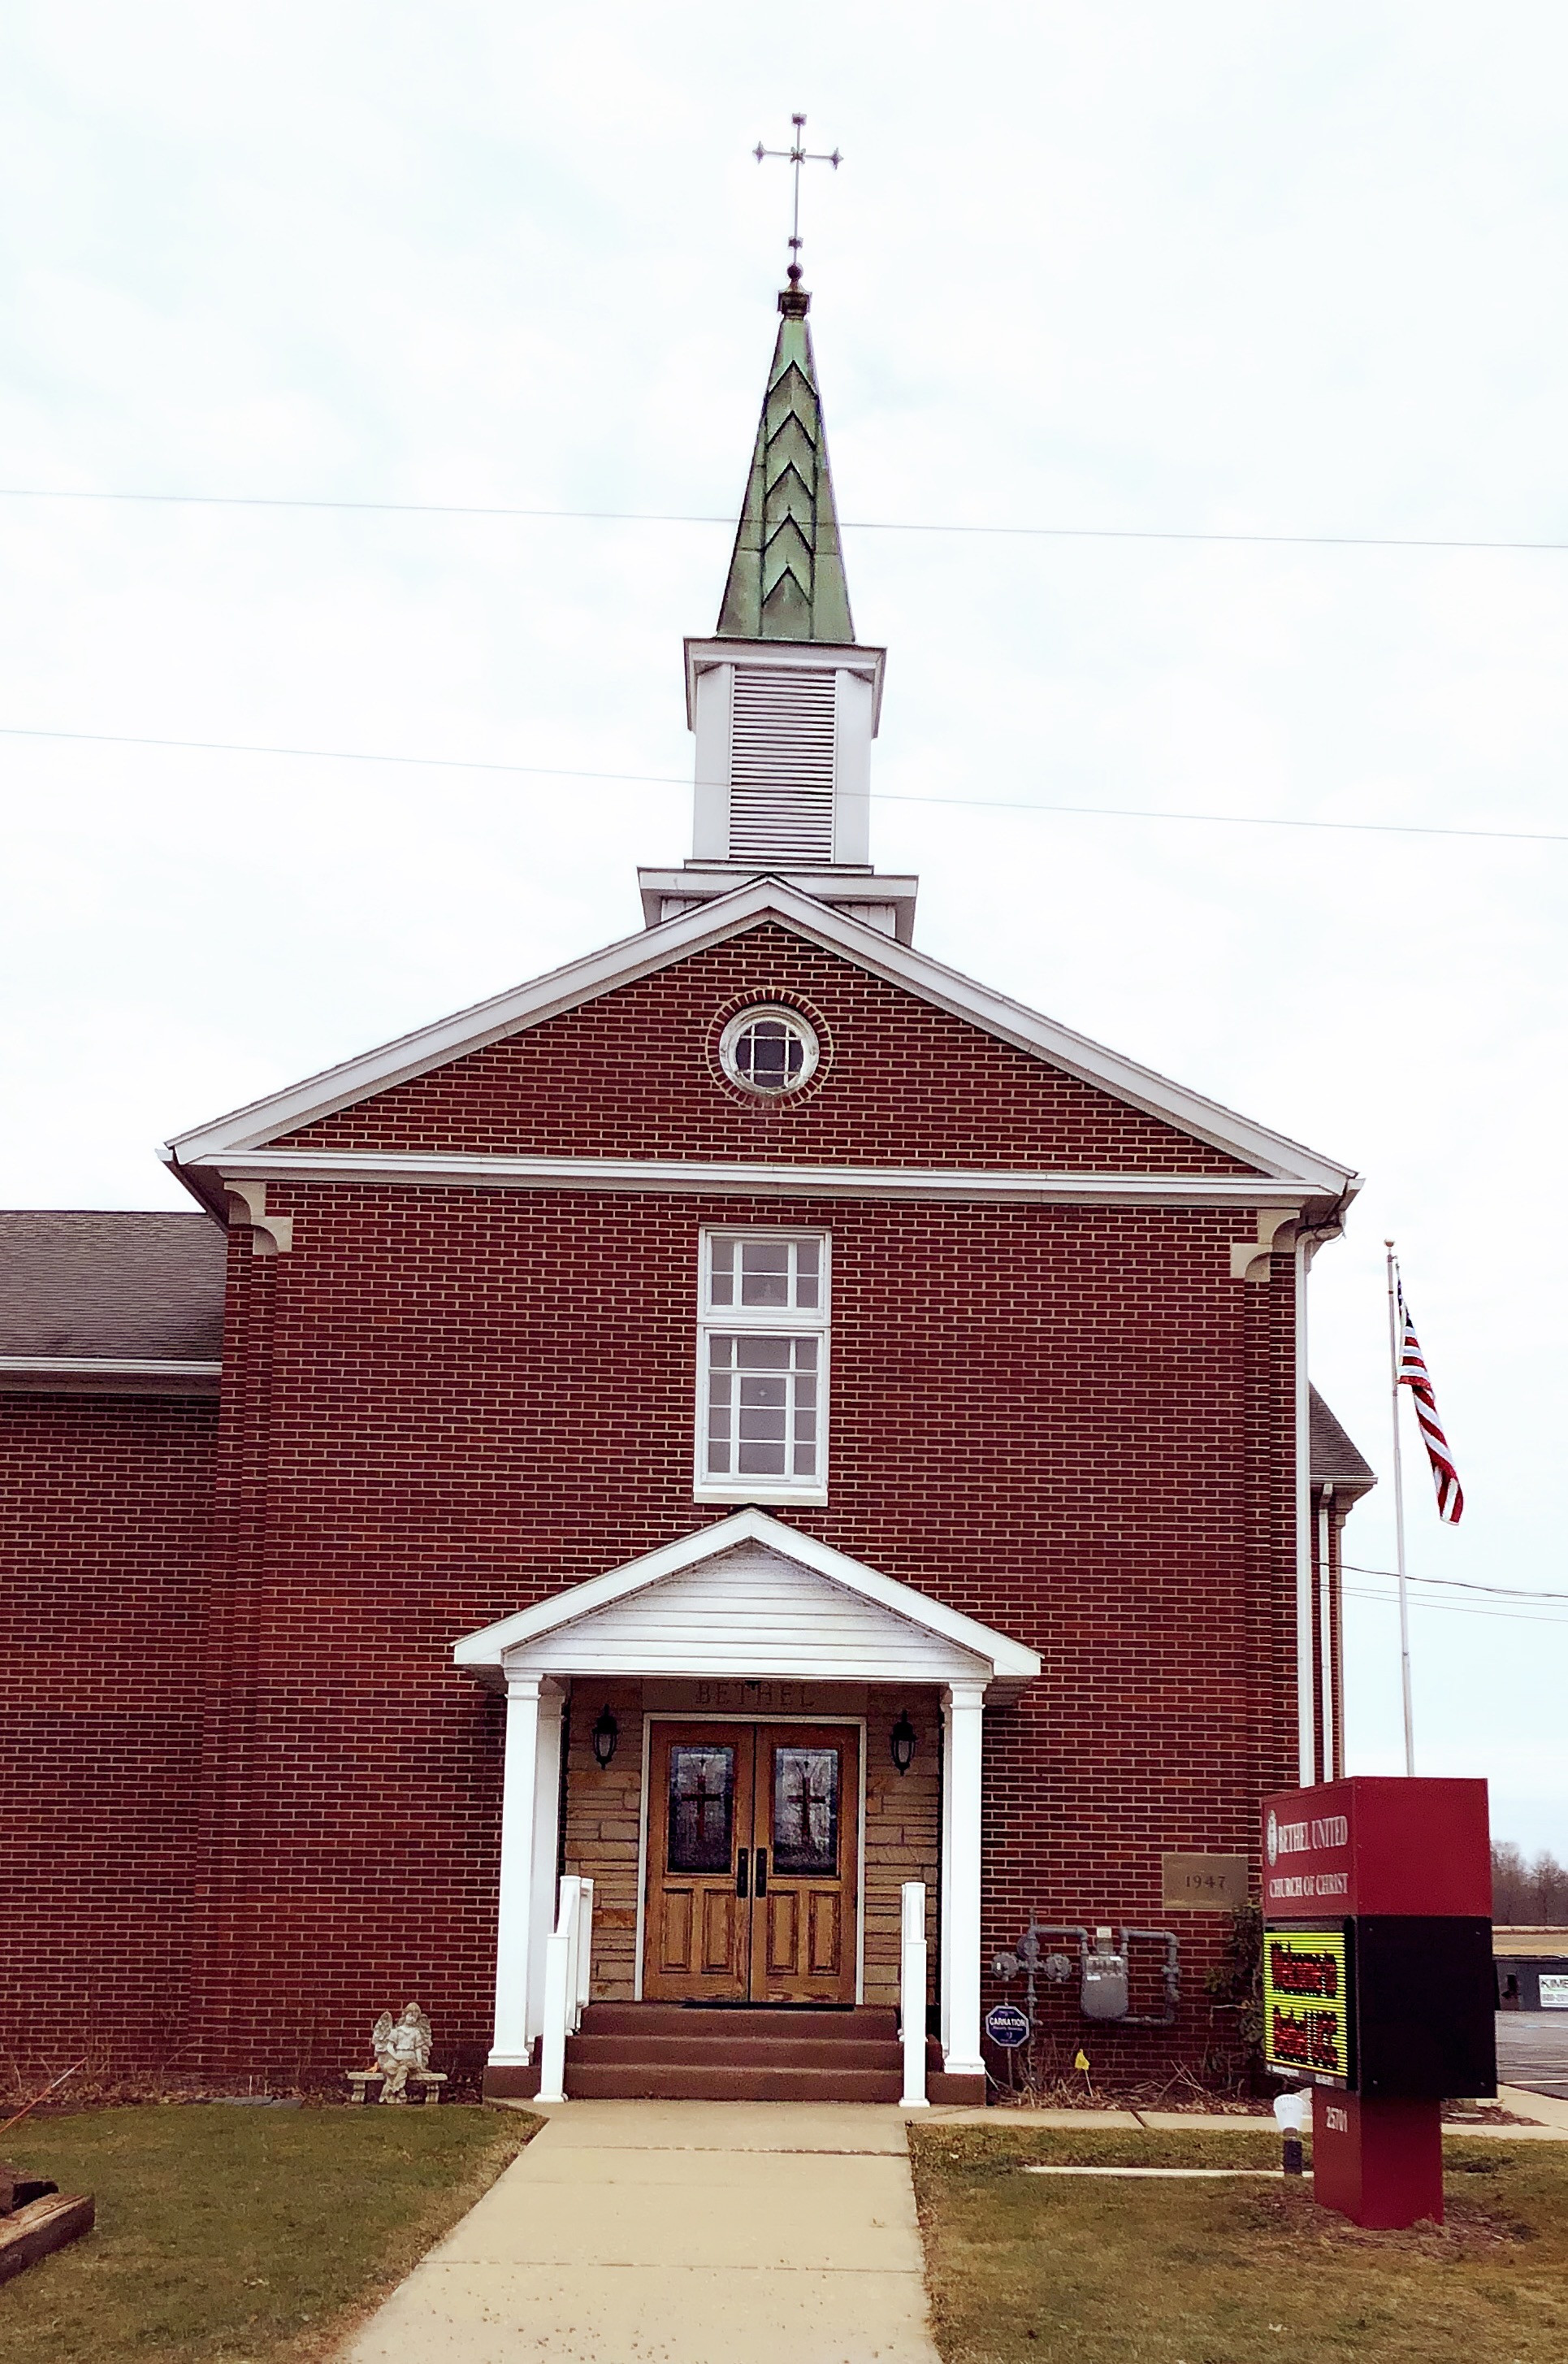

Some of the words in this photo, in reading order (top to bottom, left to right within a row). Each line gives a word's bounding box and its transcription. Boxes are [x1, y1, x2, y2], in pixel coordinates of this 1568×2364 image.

[693, 1681, 815, 1707] BETHEL
[1278, 1822, 1310, 1853] BETHEL
[1312, 1815, 1348, 1849] UNITED
[1186, 1875, 1226, 1889] 1947
[1269, 1877, 1303, 1898] CHURCH
[1316, 1873, 1349, 1895] CHRIST
